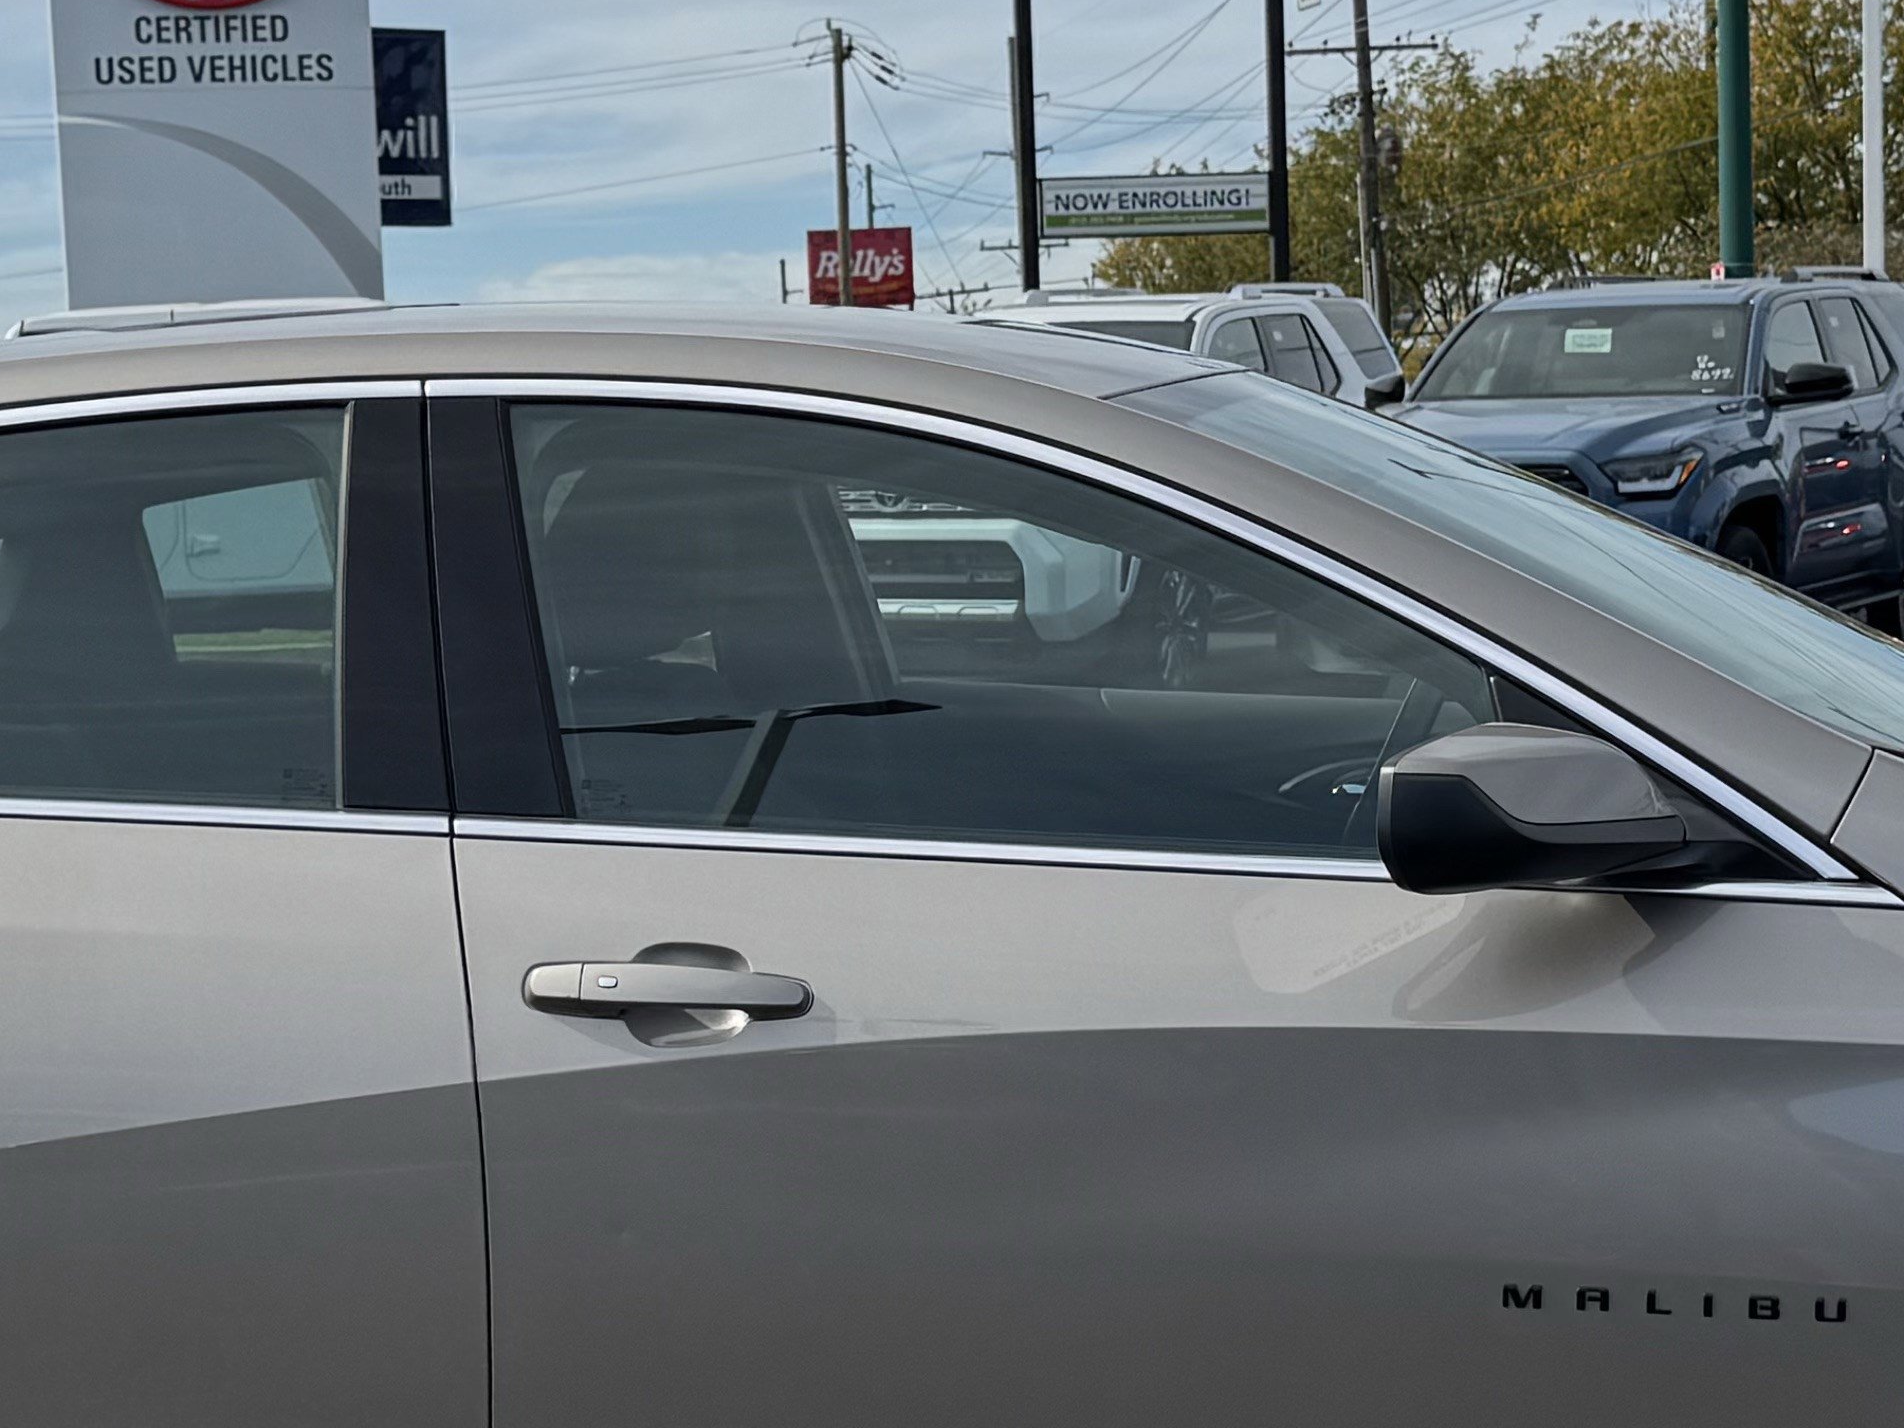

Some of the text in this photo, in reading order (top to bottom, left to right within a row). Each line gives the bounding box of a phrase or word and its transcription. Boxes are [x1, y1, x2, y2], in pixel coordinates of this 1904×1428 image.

[134, 14, 289, 45] CERTIFIED
[94, 53, 334, 85] USED VEHICLES
[379, 178, 412, 196] uth
[1054, 188, 1250, 212] NOW ENROLLING!
[815, 247, 905, 283] Rlly's
[1501, 1283, 1848, 1323] MALIBU
